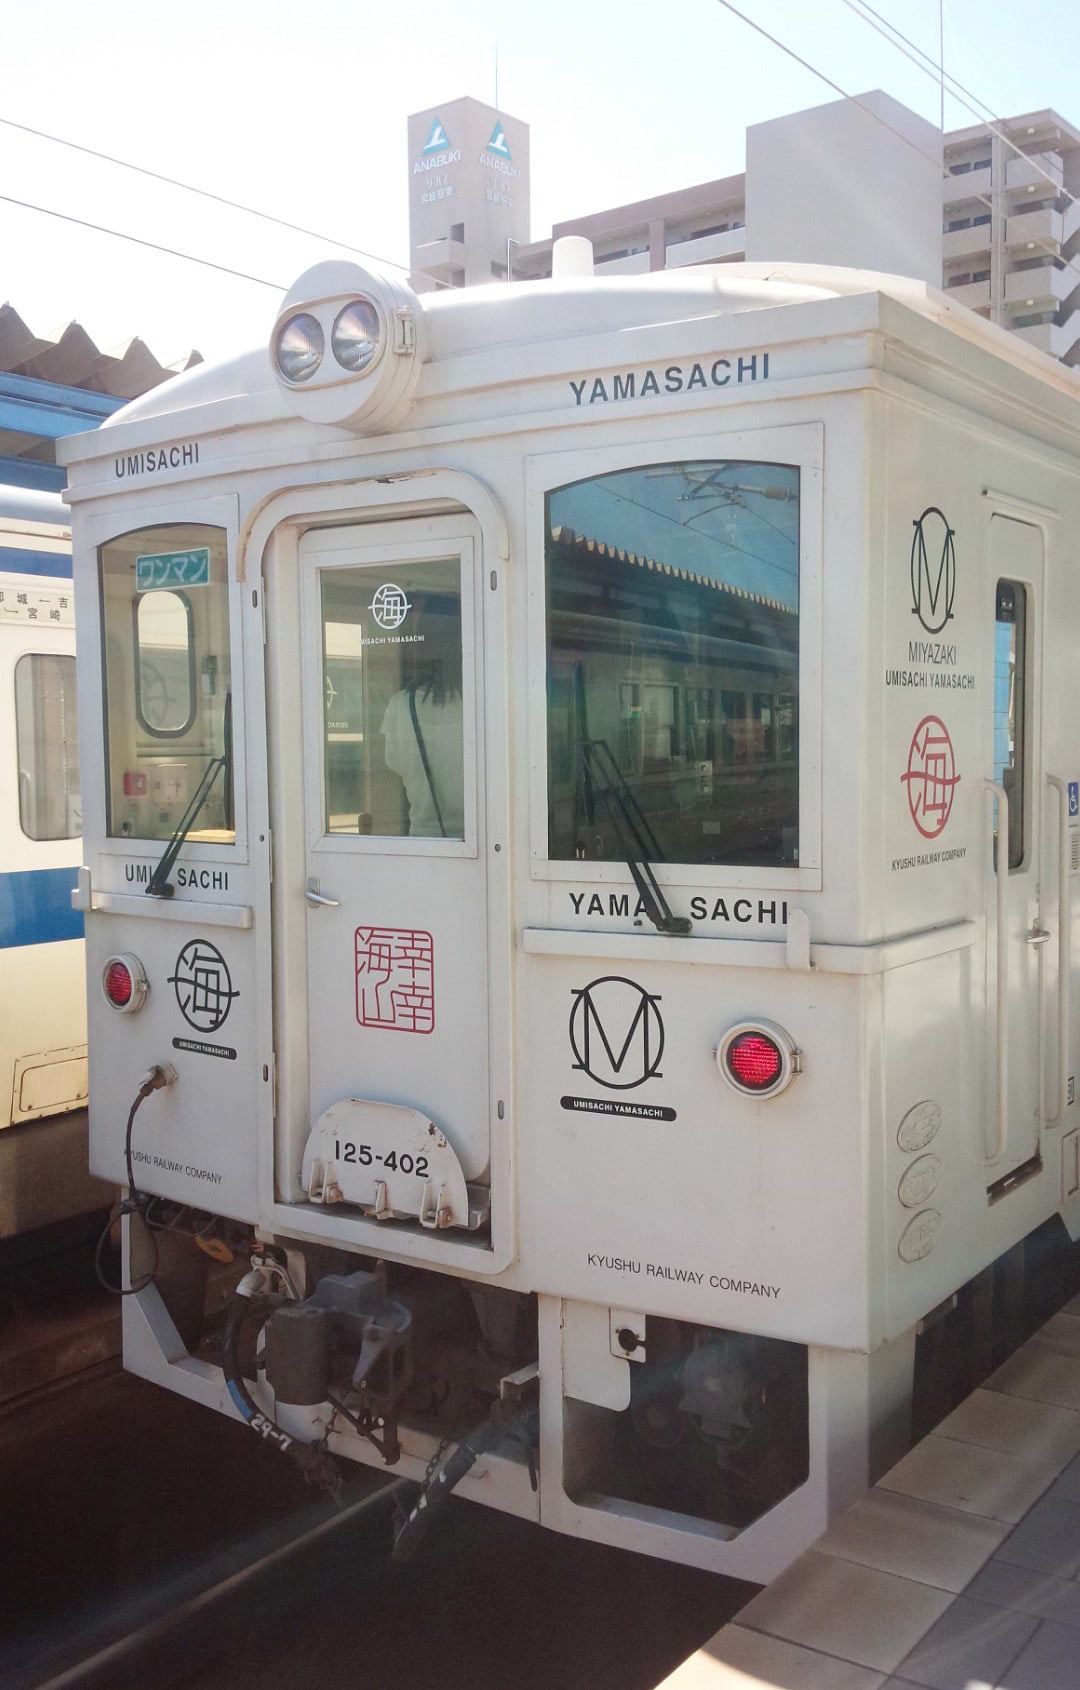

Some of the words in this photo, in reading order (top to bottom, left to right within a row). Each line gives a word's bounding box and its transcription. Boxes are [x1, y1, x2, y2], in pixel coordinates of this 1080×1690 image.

[413, 151, 461, 175] ANABUKI
[480, 153, 520, 178] ANABUKI
[569, 352, 769, 405] YAMASACHI
[115, 442, 200, 478] UMISACHI
[138, 553, 208, 587] ワンマン
[387, 634, 425, 644] YAMASACHI
[908, 642, 957, 664] MIYAZAKI
[885, 670, 928, 687] UMISACHI
[930, 673, 975, 689] YAMASACHI
[892, 856, 916, 872] KYUSHU
[917, 852, 941, 866] RAILWAY
[941, 847, 967, 862] COMPANY
[177, 867, 229, 891] SACHI
[689, 896, 788, 925] SACHI
[178, 1041, 201, 1052] UMISACHI
[201, 1045, 230, 1057] YAMASACHI
[573, 1100, 613, 1113] UMISACHI
[614, 1103, 664, 1118] YAMASACHI
[154, 1156, 183, 1174] RAILWAY
[185, 1166, 222, 1185] COMPANY
[335, 1139, 429, 1178] 125-402
[587, 1253, 641, 1274] KYUSHU
[646, 1263, 704, 1286] RAILWAY
[709, 1275, 781, 1300] COMPANY
[251, 1413, 293, 1451] 29-7
